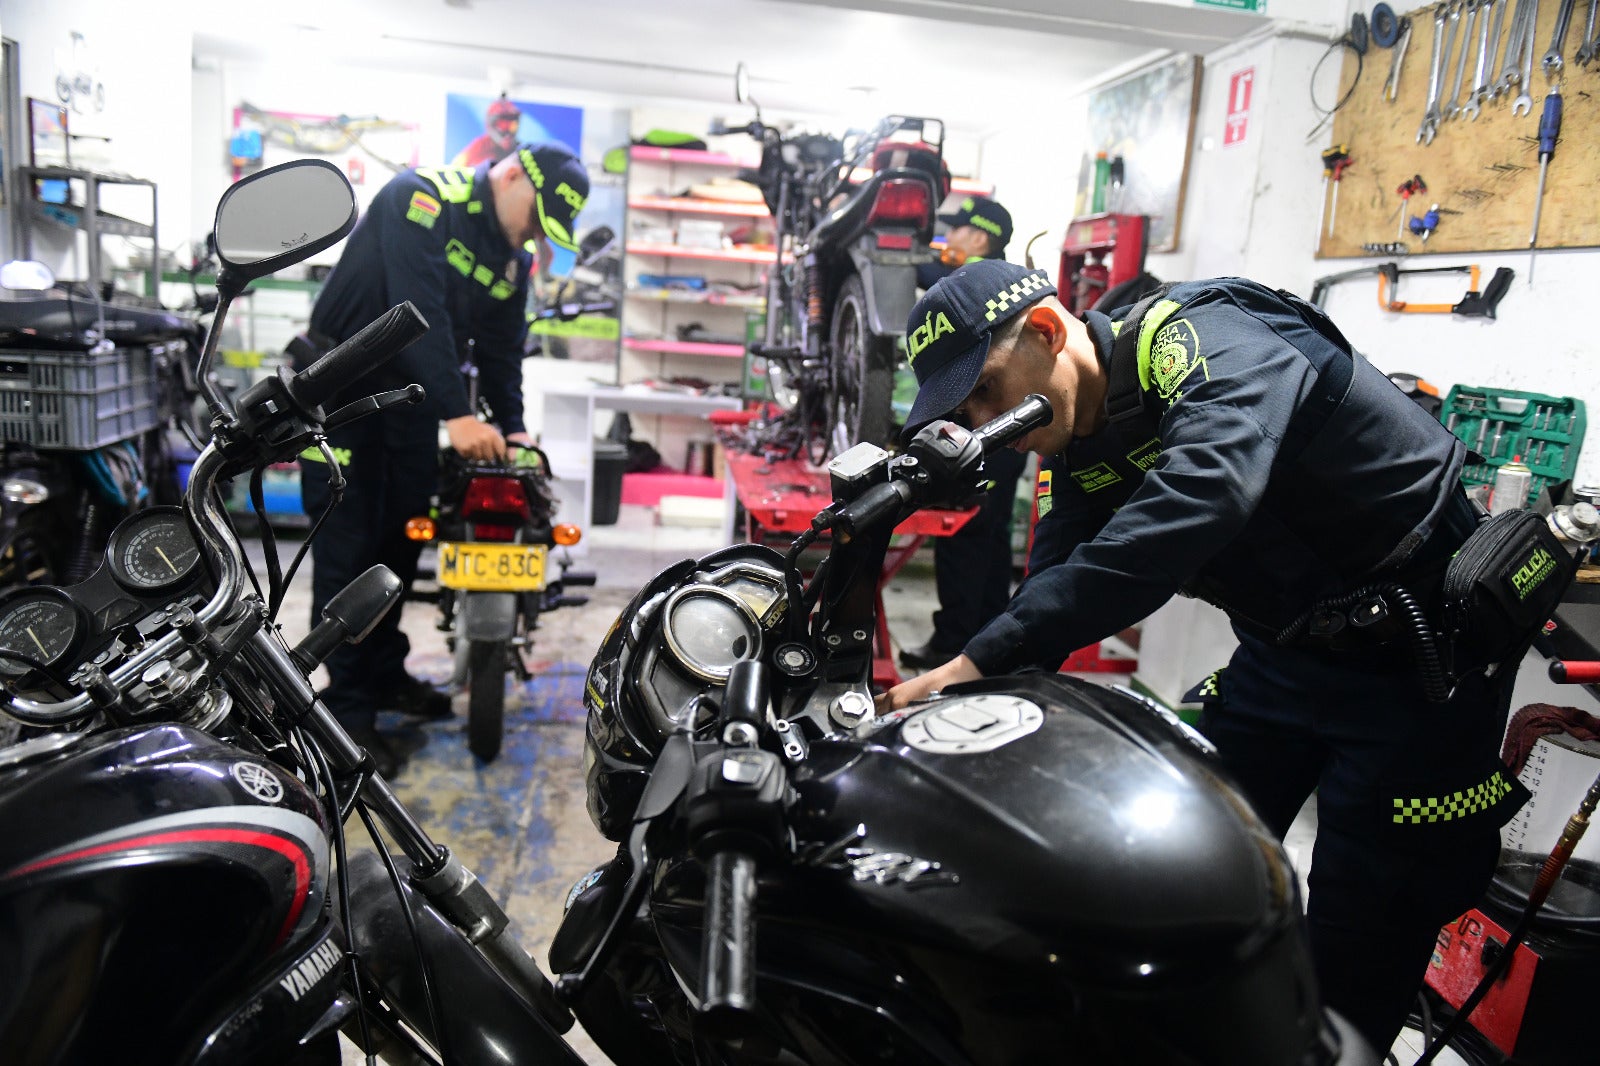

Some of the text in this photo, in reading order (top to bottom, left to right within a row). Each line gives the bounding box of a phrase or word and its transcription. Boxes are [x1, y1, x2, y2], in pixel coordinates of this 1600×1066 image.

[906, 311, 956, 366] LICÍA
[1511, 548, 1552, 591] POLICÍA
[1540, 745, 1548, 754] 15
[1537, 756, 1545, 764] 14
[1535, 767, 1543, 776] 13
[1532, 778, 1540, 787] 12
[279, 938, 343, 1002] YAMAHA
